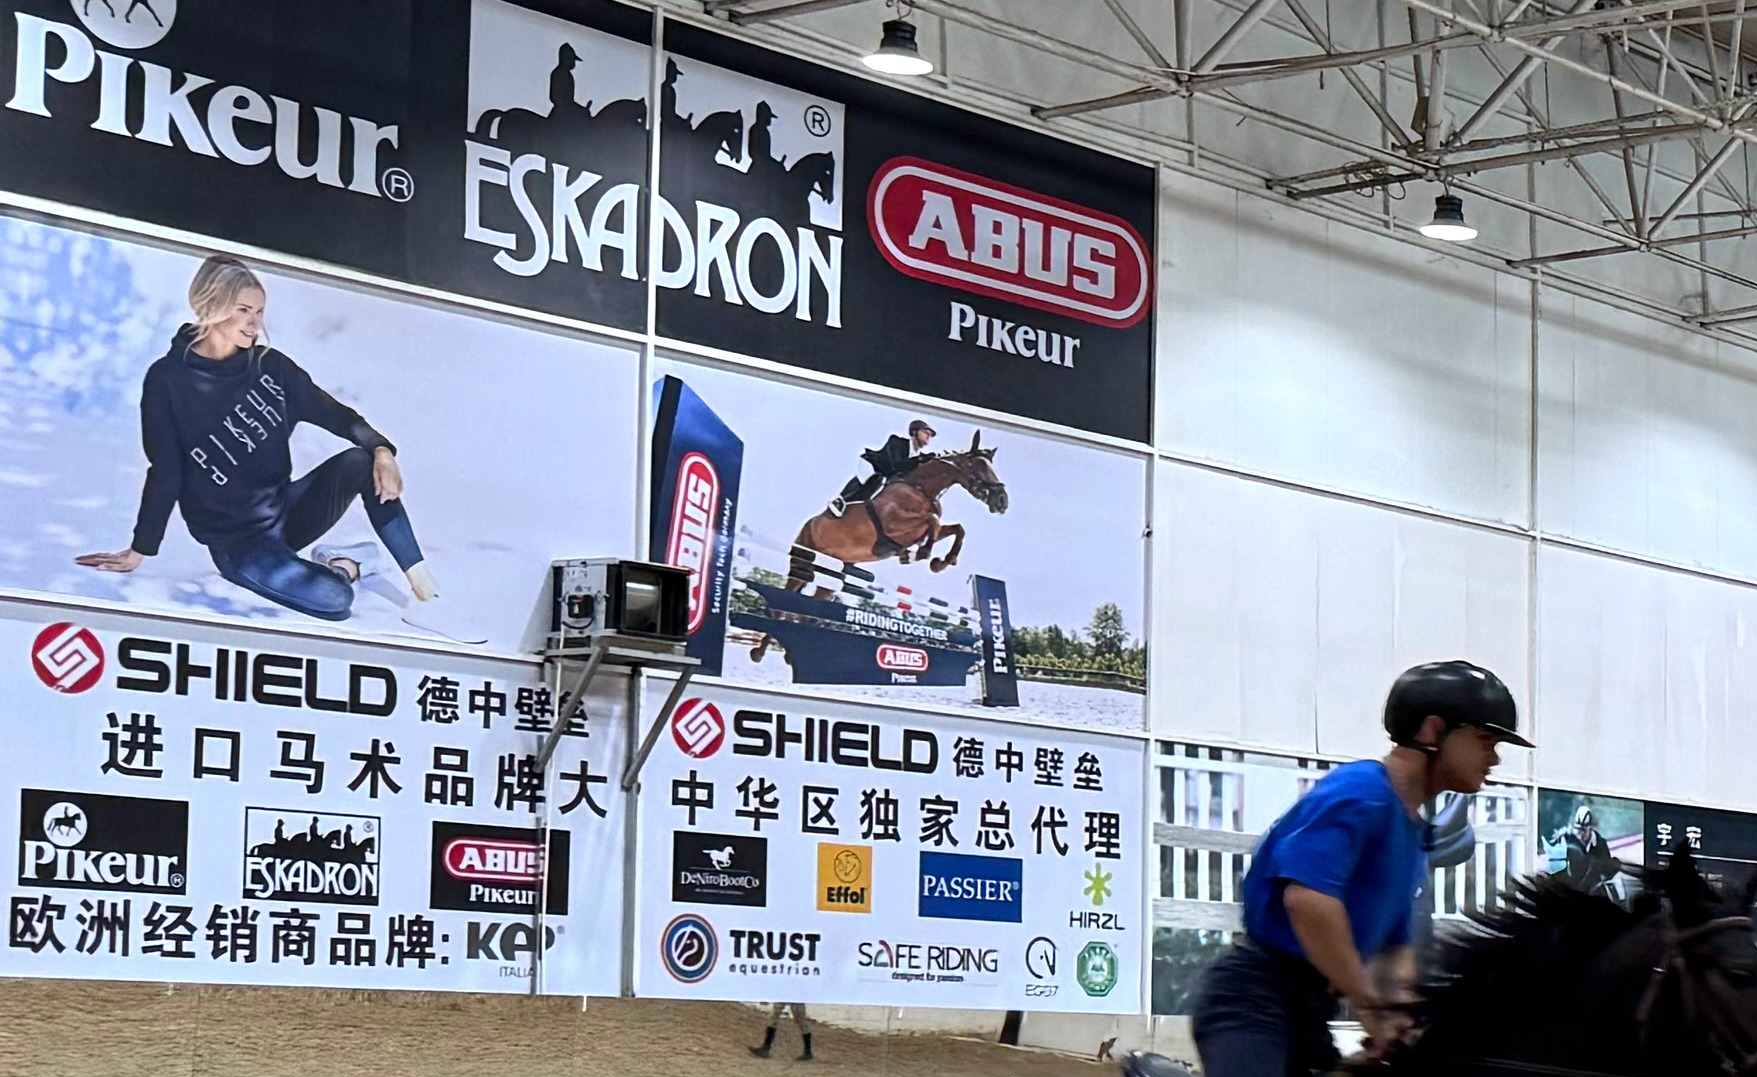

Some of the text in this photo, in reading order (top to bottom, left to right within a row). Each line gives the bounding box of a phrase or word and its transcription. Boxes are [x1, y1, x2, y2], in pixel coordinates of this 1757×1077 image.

[464, 139, 843, 329] ESKADRON
[908, 190, 1117, 299] ABUS
[846, 608, 948, 641] #RIDINGTOGETHER
[884, 649, 923, 667] ABUS
[117, 637, 397, 717] SHIELD
[733, 710, 938, 773] SHIELD
[101, 712, 608, 818] 进口马术品牌大
[953, 736, 1104, 792] 德中壁垒
[671, 770, 1121, 859] 中华区独家总代理
[245, 857, 378, 898] ESKADRON
[827, 887, 866, 904] Effol
[923, 874, 1013, 902] PASSIER
[1069, 911, 1126, 930] HIRZL
[729, 930, 821, 961] TRUST
[858, 940, 998, 972] SAFE RIDING
[729, 962, 820, 976] equestrian
